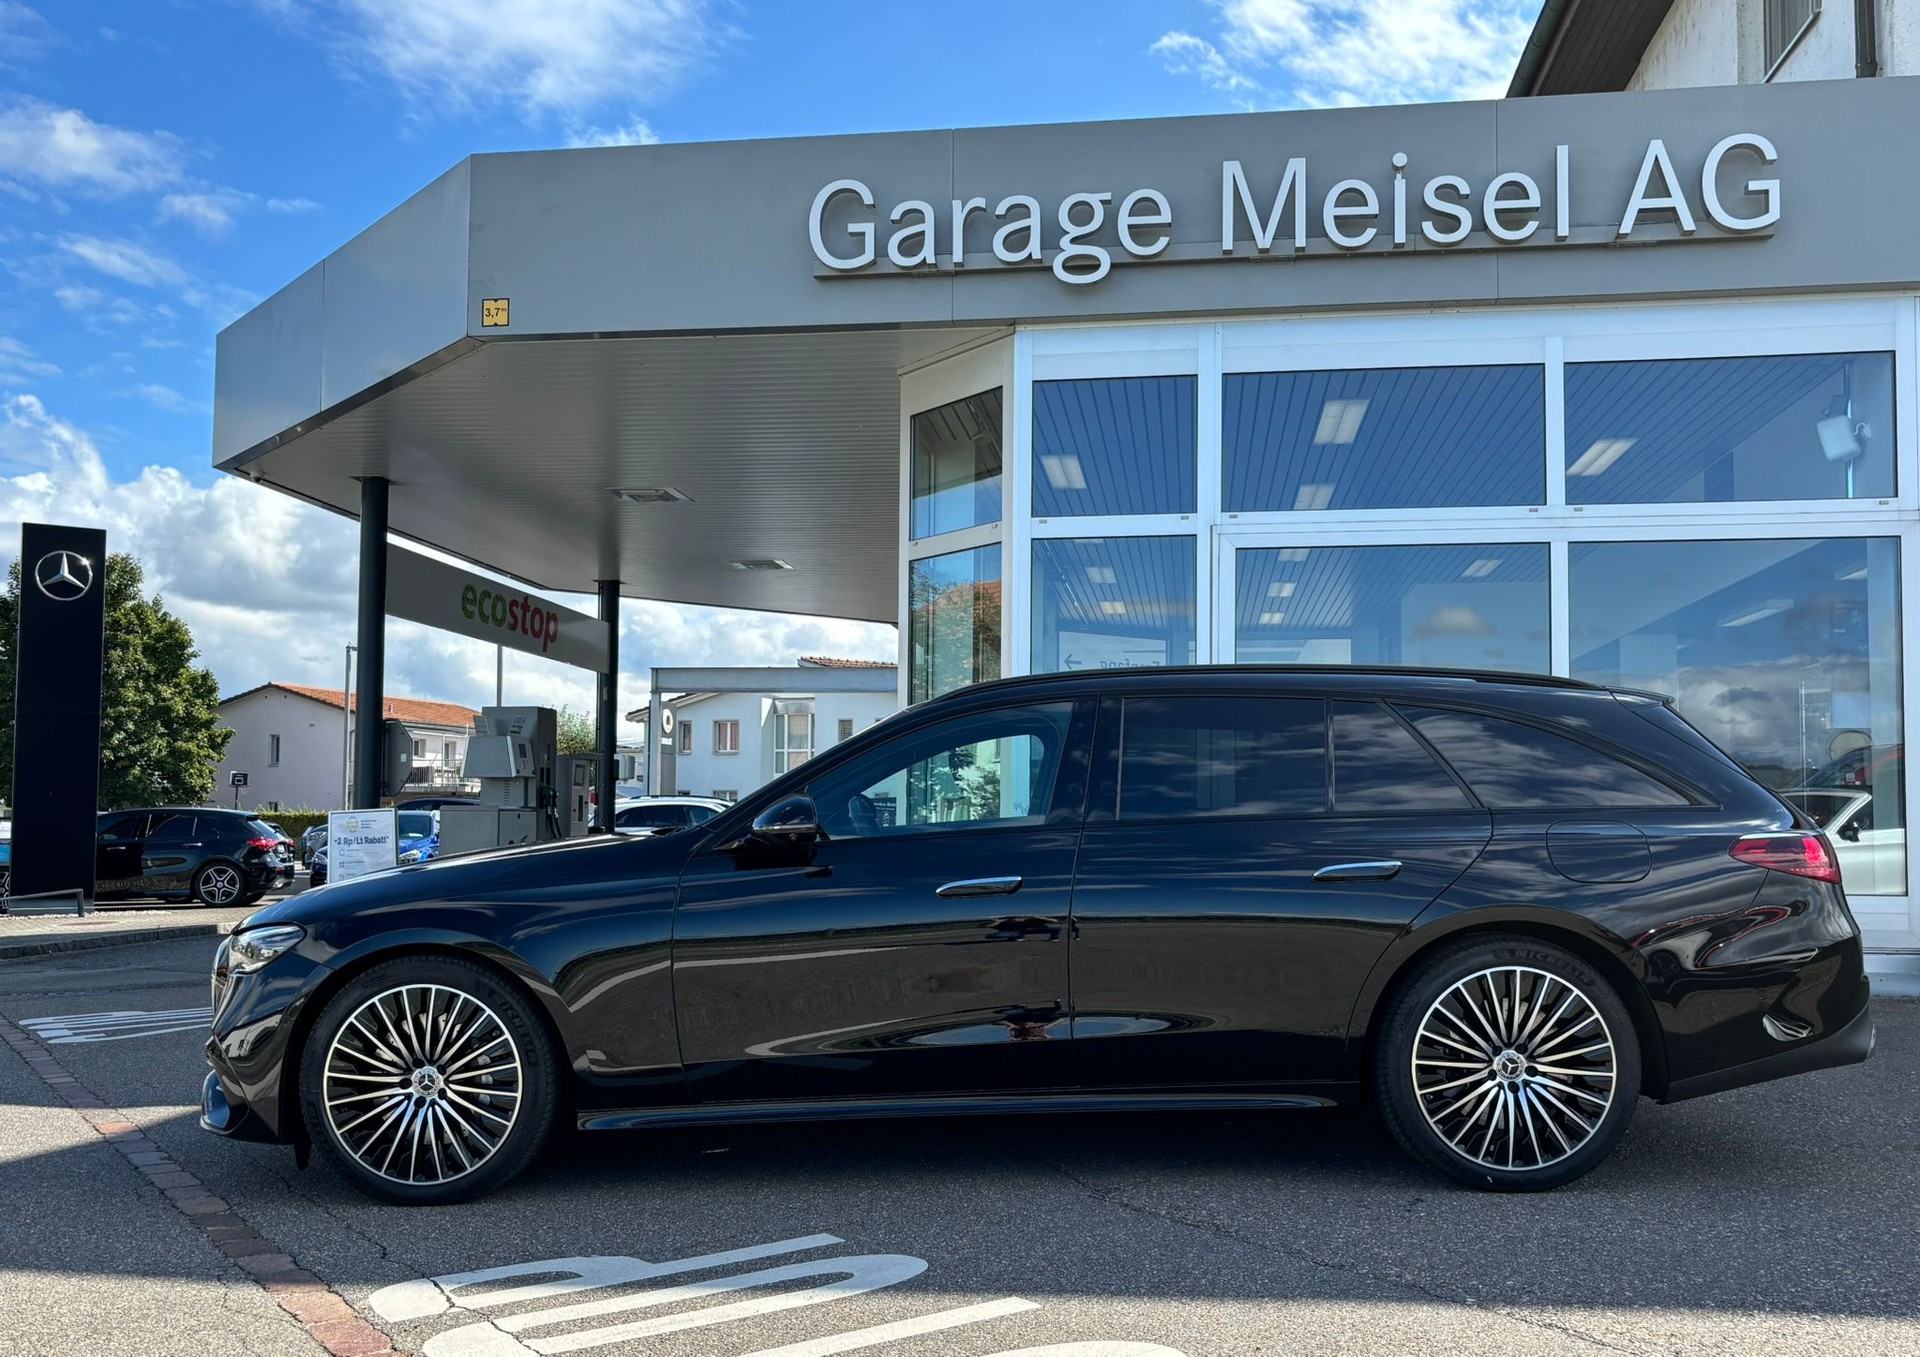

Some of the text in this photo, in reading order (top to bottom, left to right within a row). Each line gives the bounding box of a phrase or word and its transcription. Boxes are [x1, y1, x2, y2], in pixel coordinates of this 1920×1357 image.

[808, 133, 1782, 284] Garage Meisel AG
[461, 583, 559, 652] ecostop
